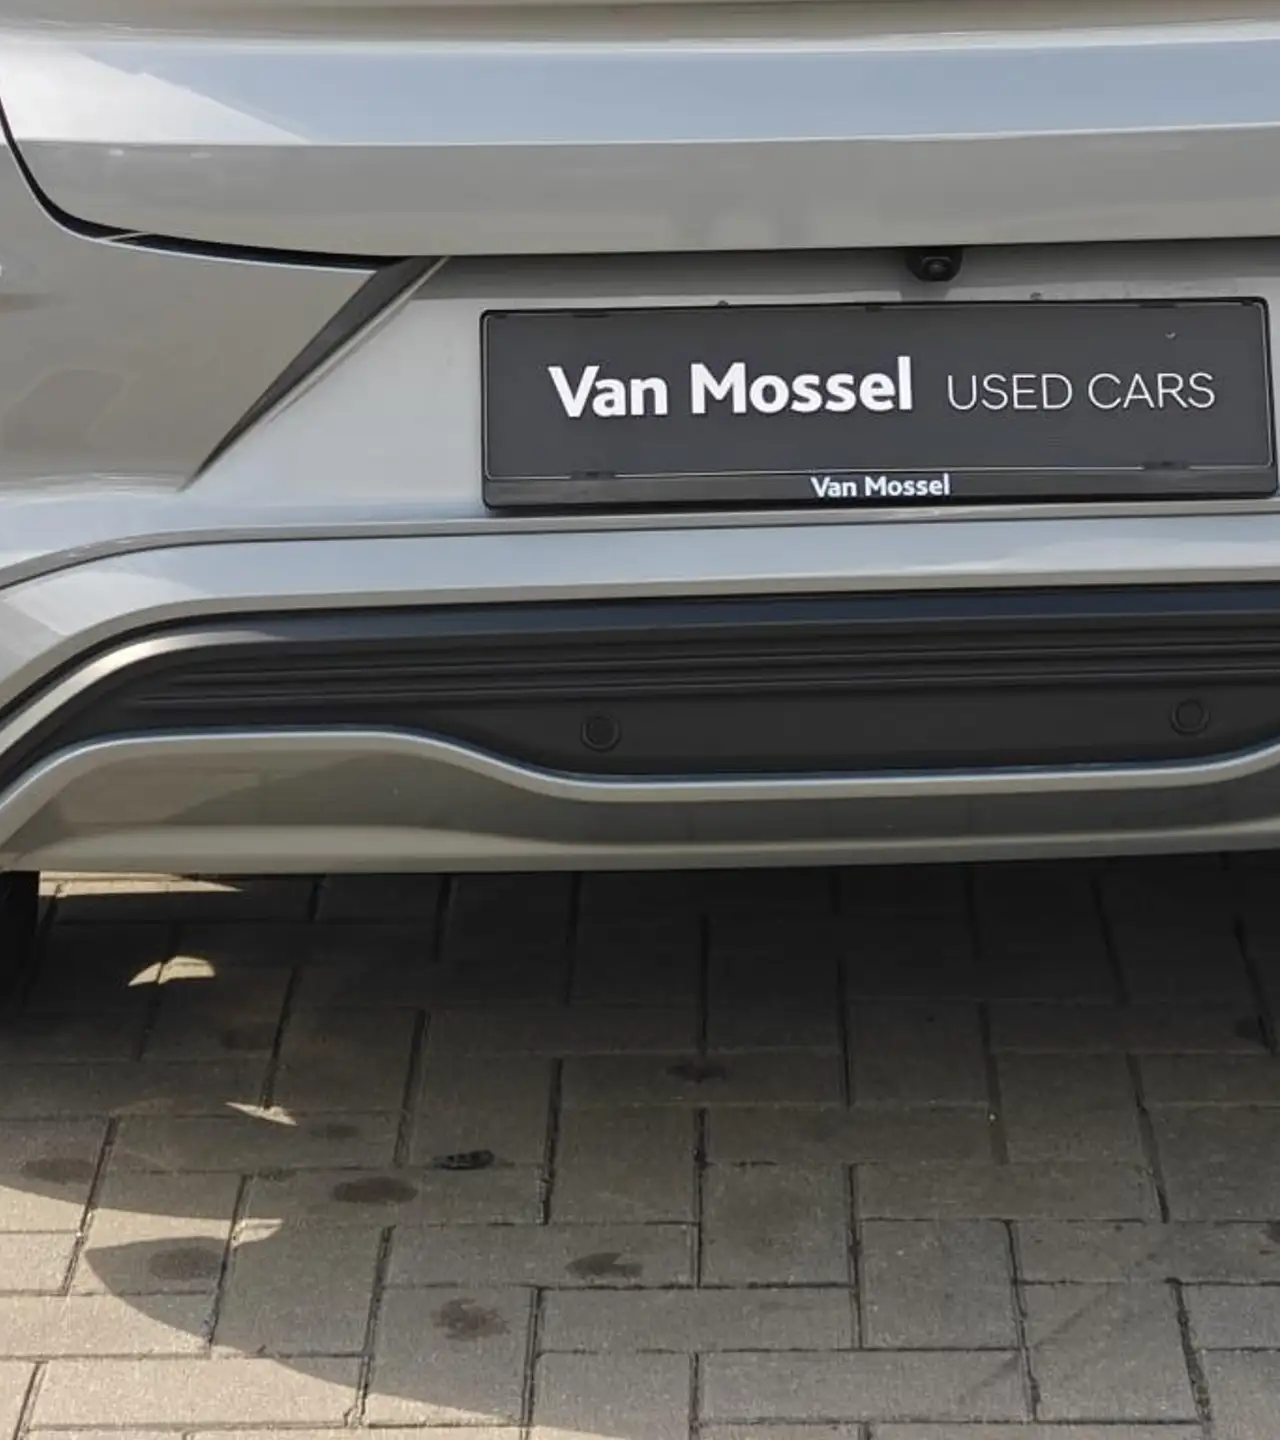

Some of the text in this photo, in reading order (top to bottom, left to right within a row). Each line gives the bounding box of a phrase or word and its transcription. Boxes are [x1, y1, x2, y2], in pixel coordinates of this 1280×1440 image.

[548, 356, 1217, 418] Van Mossel USED CARS
[811, 473, 951, 498] Van Mossel
